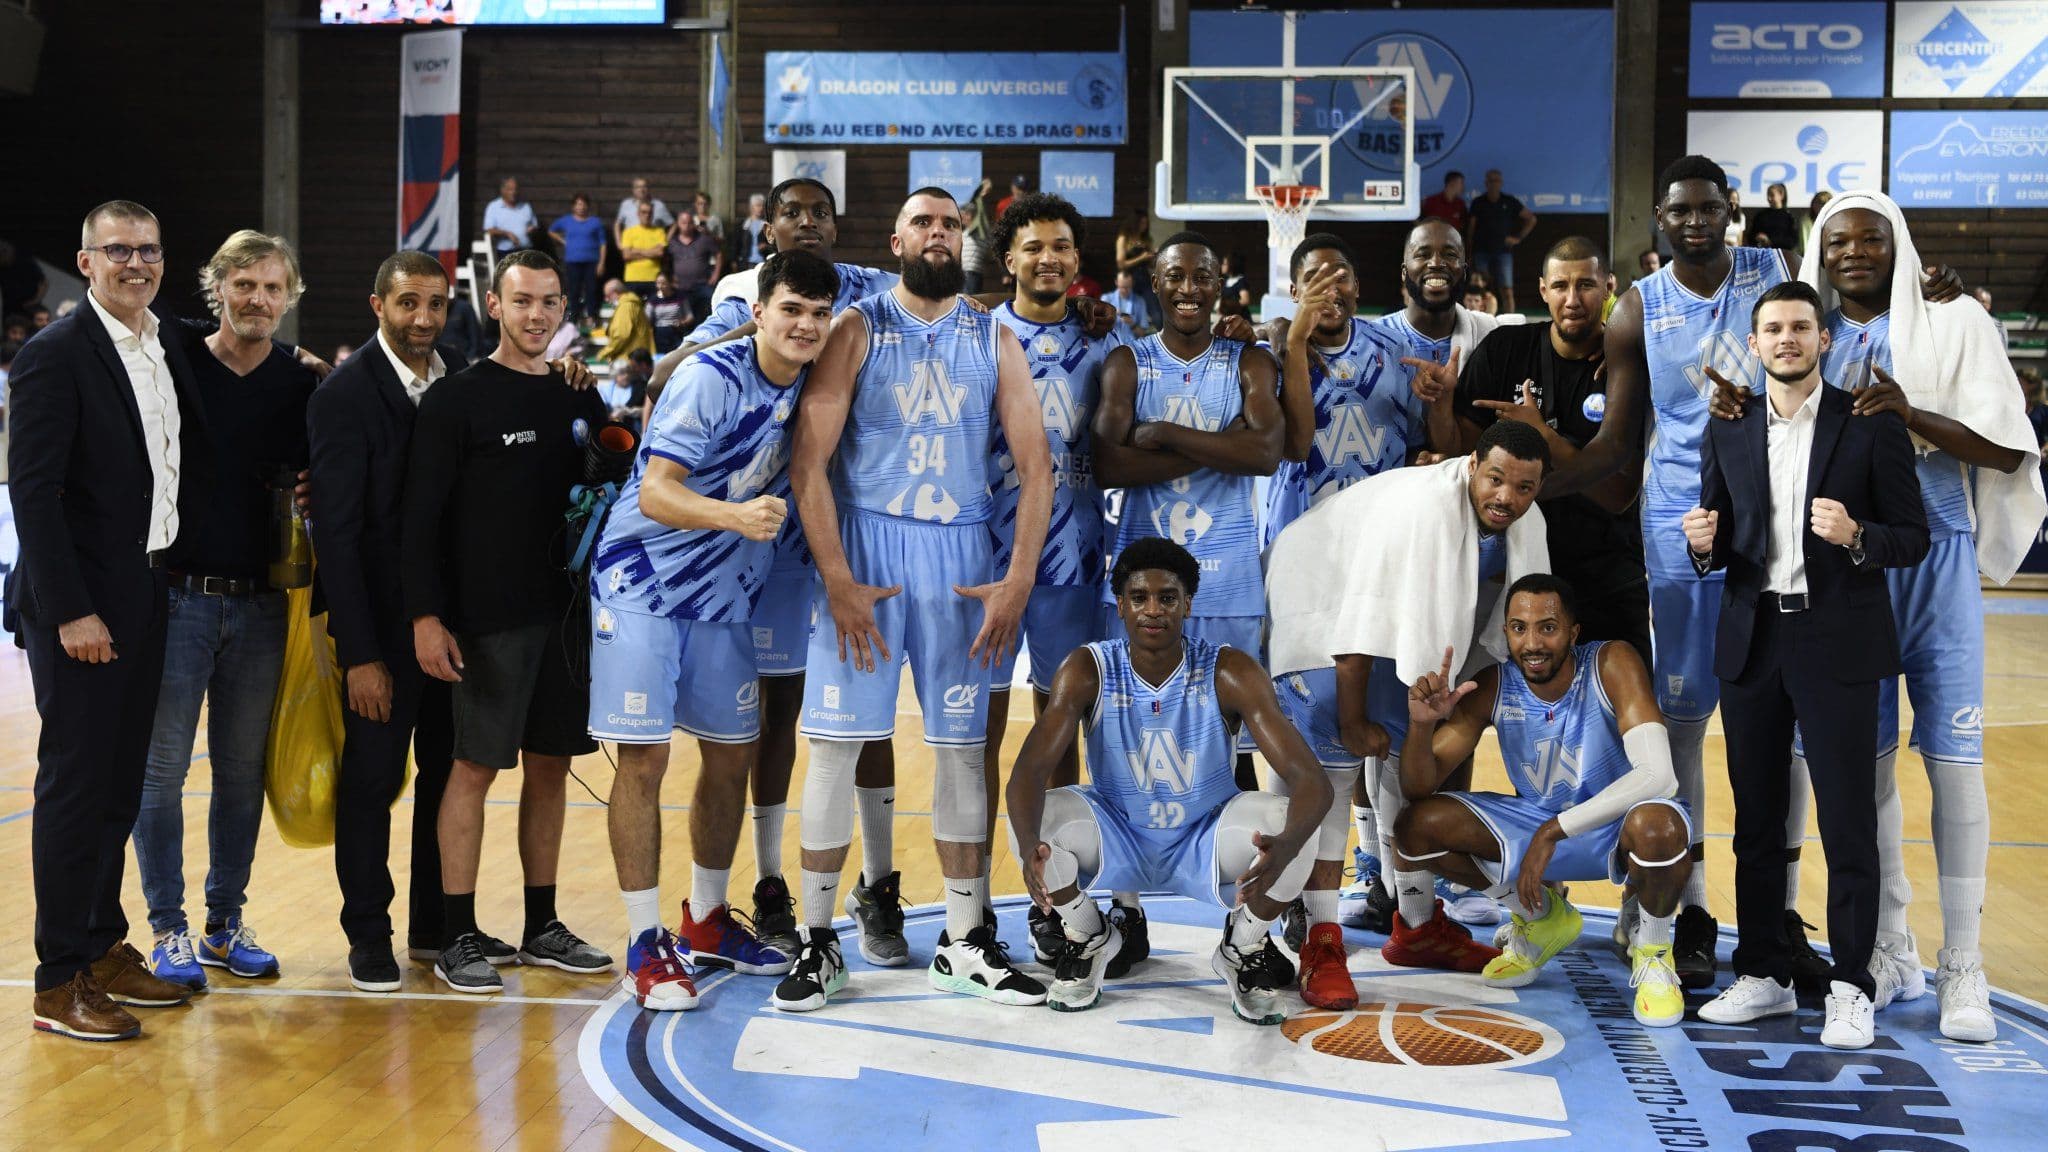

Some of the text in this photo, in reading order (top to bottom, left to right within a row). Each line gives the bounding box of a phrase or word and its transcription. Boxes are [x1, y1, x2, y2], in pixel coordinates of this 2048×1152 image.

[820, 81, 899, 95] DRAGON
[906, 80, 957, 95] CLUB
[963, 80, 1068, 95] AUVERGNE
[821, 124, 845, 137] AU
[932, 125, 978, 138] AVEC
[984, 125, 1018, 138] LES
[1055, 175, 1099, 190] TUKA
[1733, 281, 1768, 299] VICHY
[516, 430, 535, 438] INTER
[517, 435, 537, 444] SPORT
[907, 434, 947, 476] 34
[1051, 452, 1091, 471] NTER
[1054, 471, 1093, 488] PORT
[608, 714, 663, 728] Groupama
[809, 708, 856, 723] Groupama
[1149, 802, 1185, 828] 32
[1596, 1024, 1710, 1152] CHY-CLERMONT
